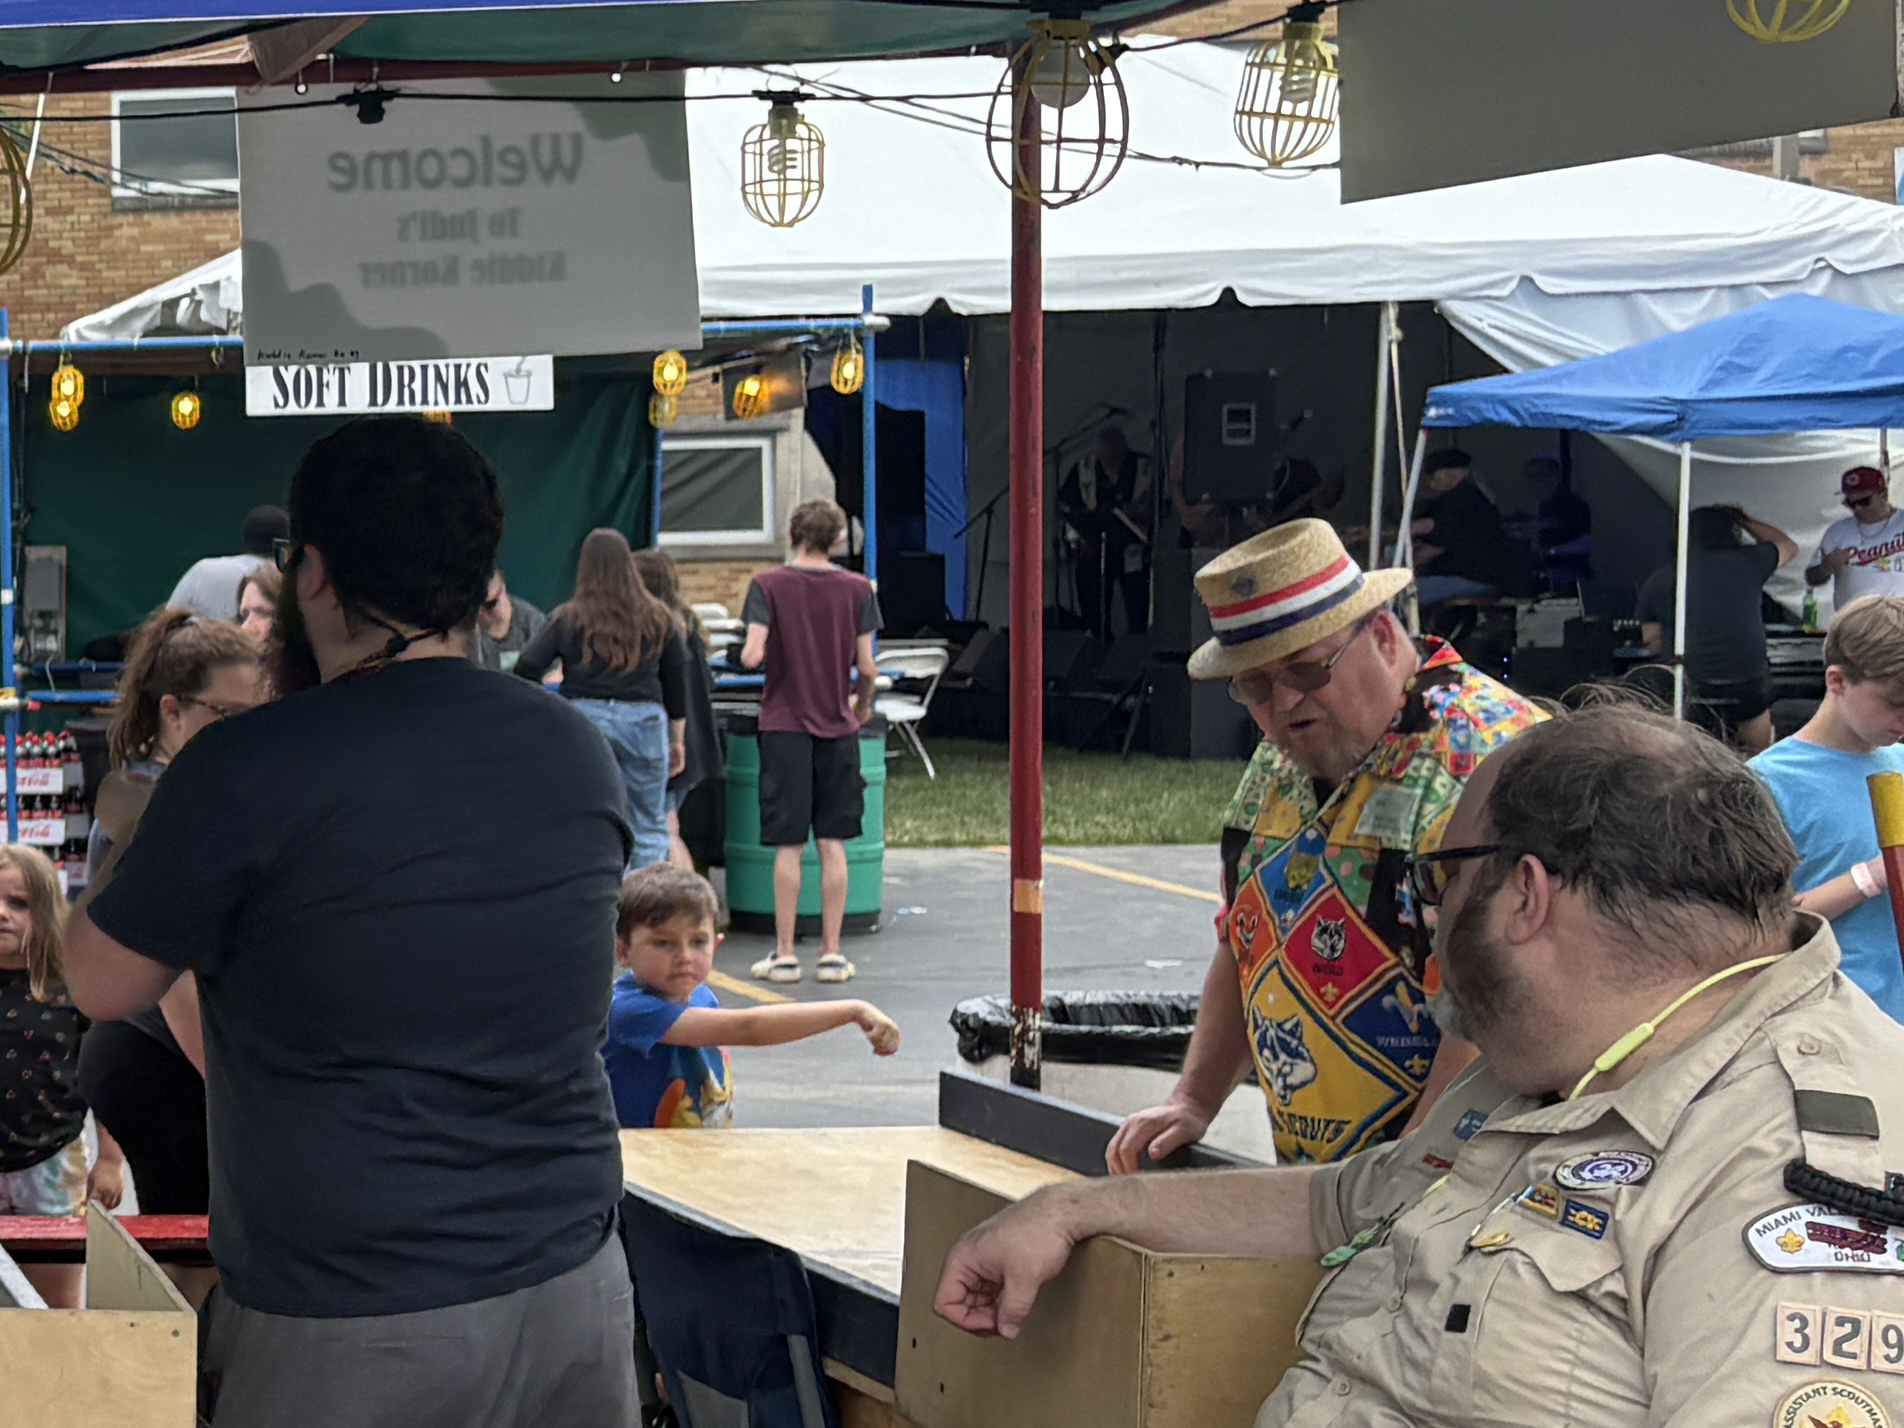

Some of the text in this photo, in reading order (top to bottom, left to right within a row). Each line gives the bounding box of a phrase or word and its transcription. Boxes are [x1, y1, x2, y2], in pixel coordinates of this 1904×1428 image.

[272, 361, 492, 409] SOFT DRINKS
[1754, 1210, 1802, 1238] MIAMI
[1784, 1311, 1904, 1364] 329
